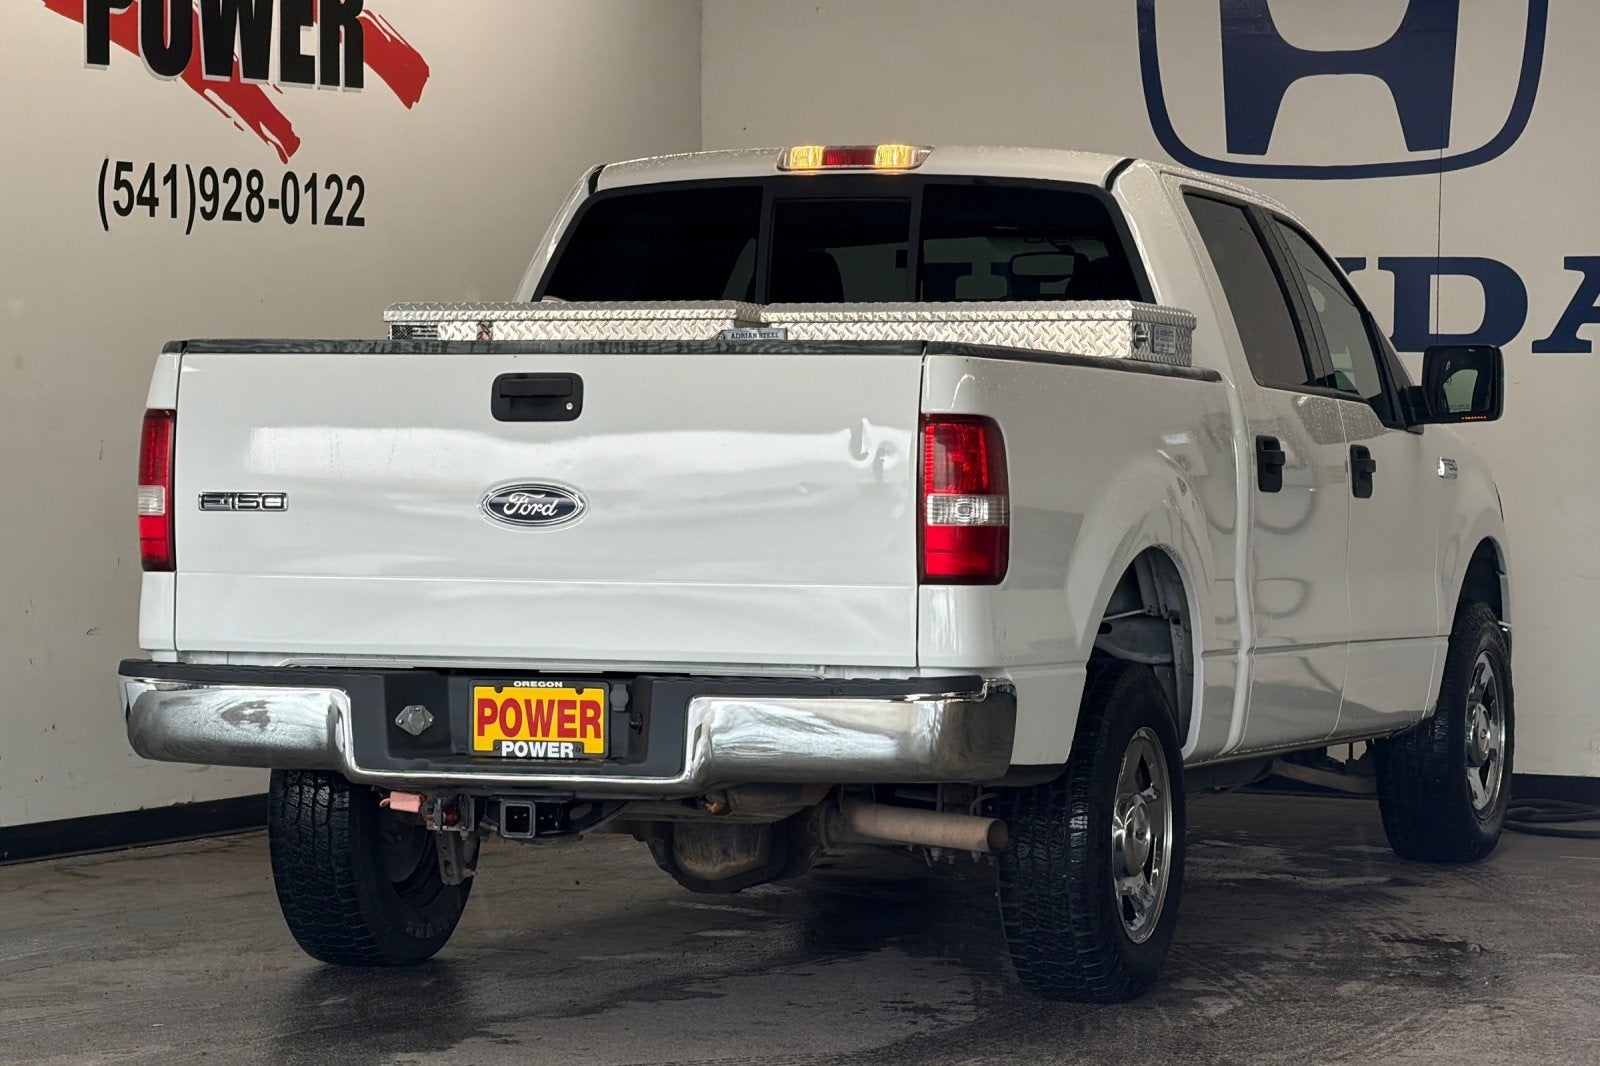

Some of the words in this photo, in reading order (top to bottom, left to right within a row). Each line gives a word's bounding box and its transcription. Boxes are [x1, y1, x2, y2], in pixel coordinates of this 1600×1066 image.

[98, 158, 365, 234] (541)928-0122
[503, 492, 560, 516] Ford
[477, 698, 602, 739] POWER
[501, 741, 574, 758] POWER
